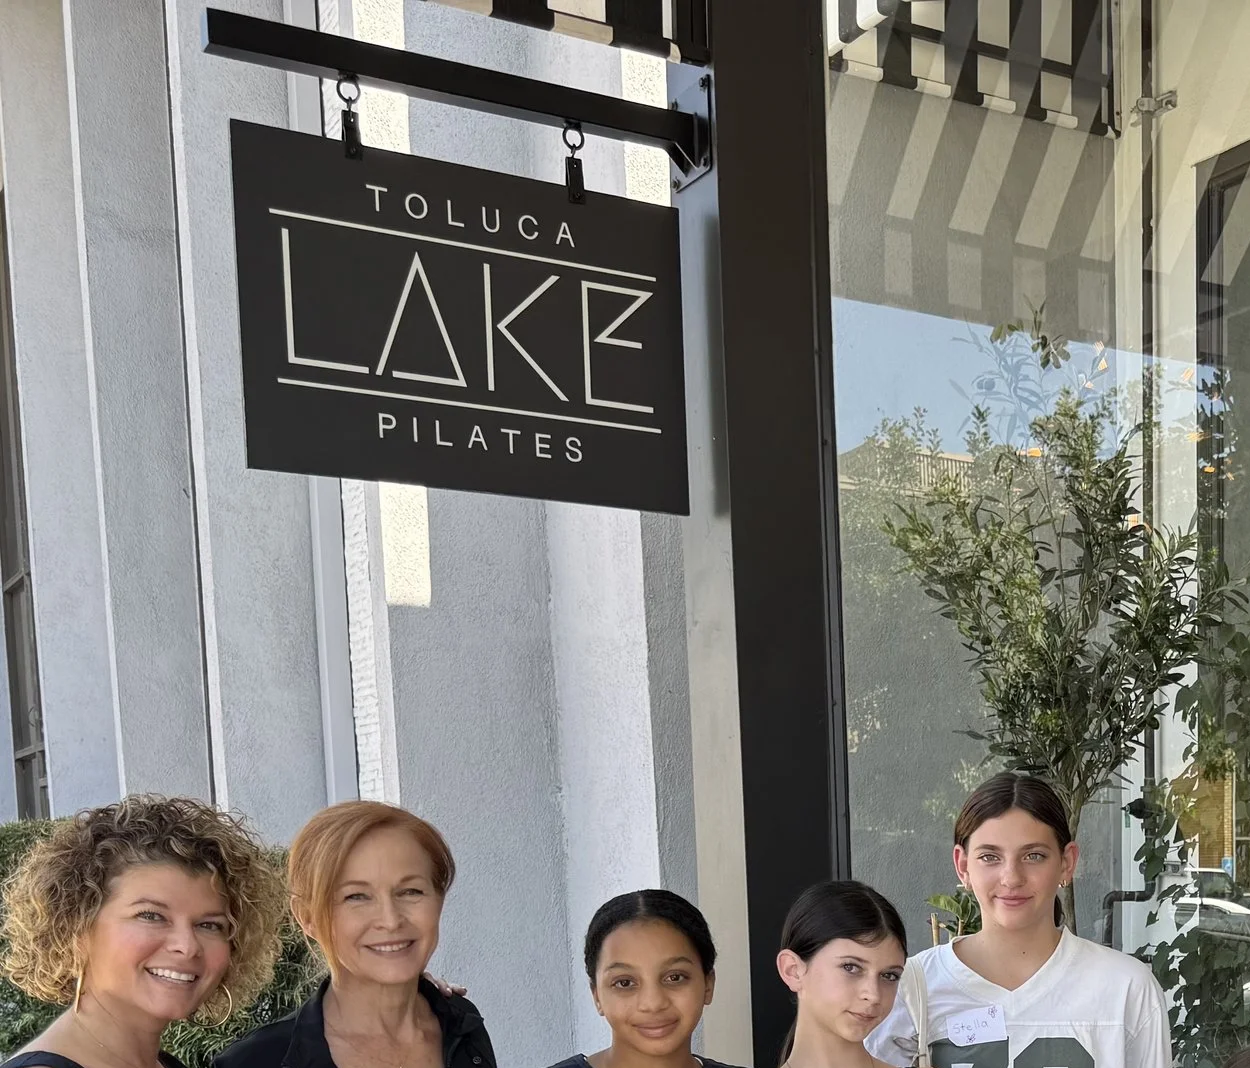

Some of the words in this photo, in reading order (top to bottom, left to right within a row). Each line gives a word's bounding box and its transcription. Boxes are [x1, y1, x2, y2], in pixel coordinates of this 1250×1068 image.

[365, 183, 575, 248] TOLUCA
[281, 228, 654, 414] LAKE
[378, 412, 584, 463] PILATES
[952, 1019, 989, 1035] Stella
